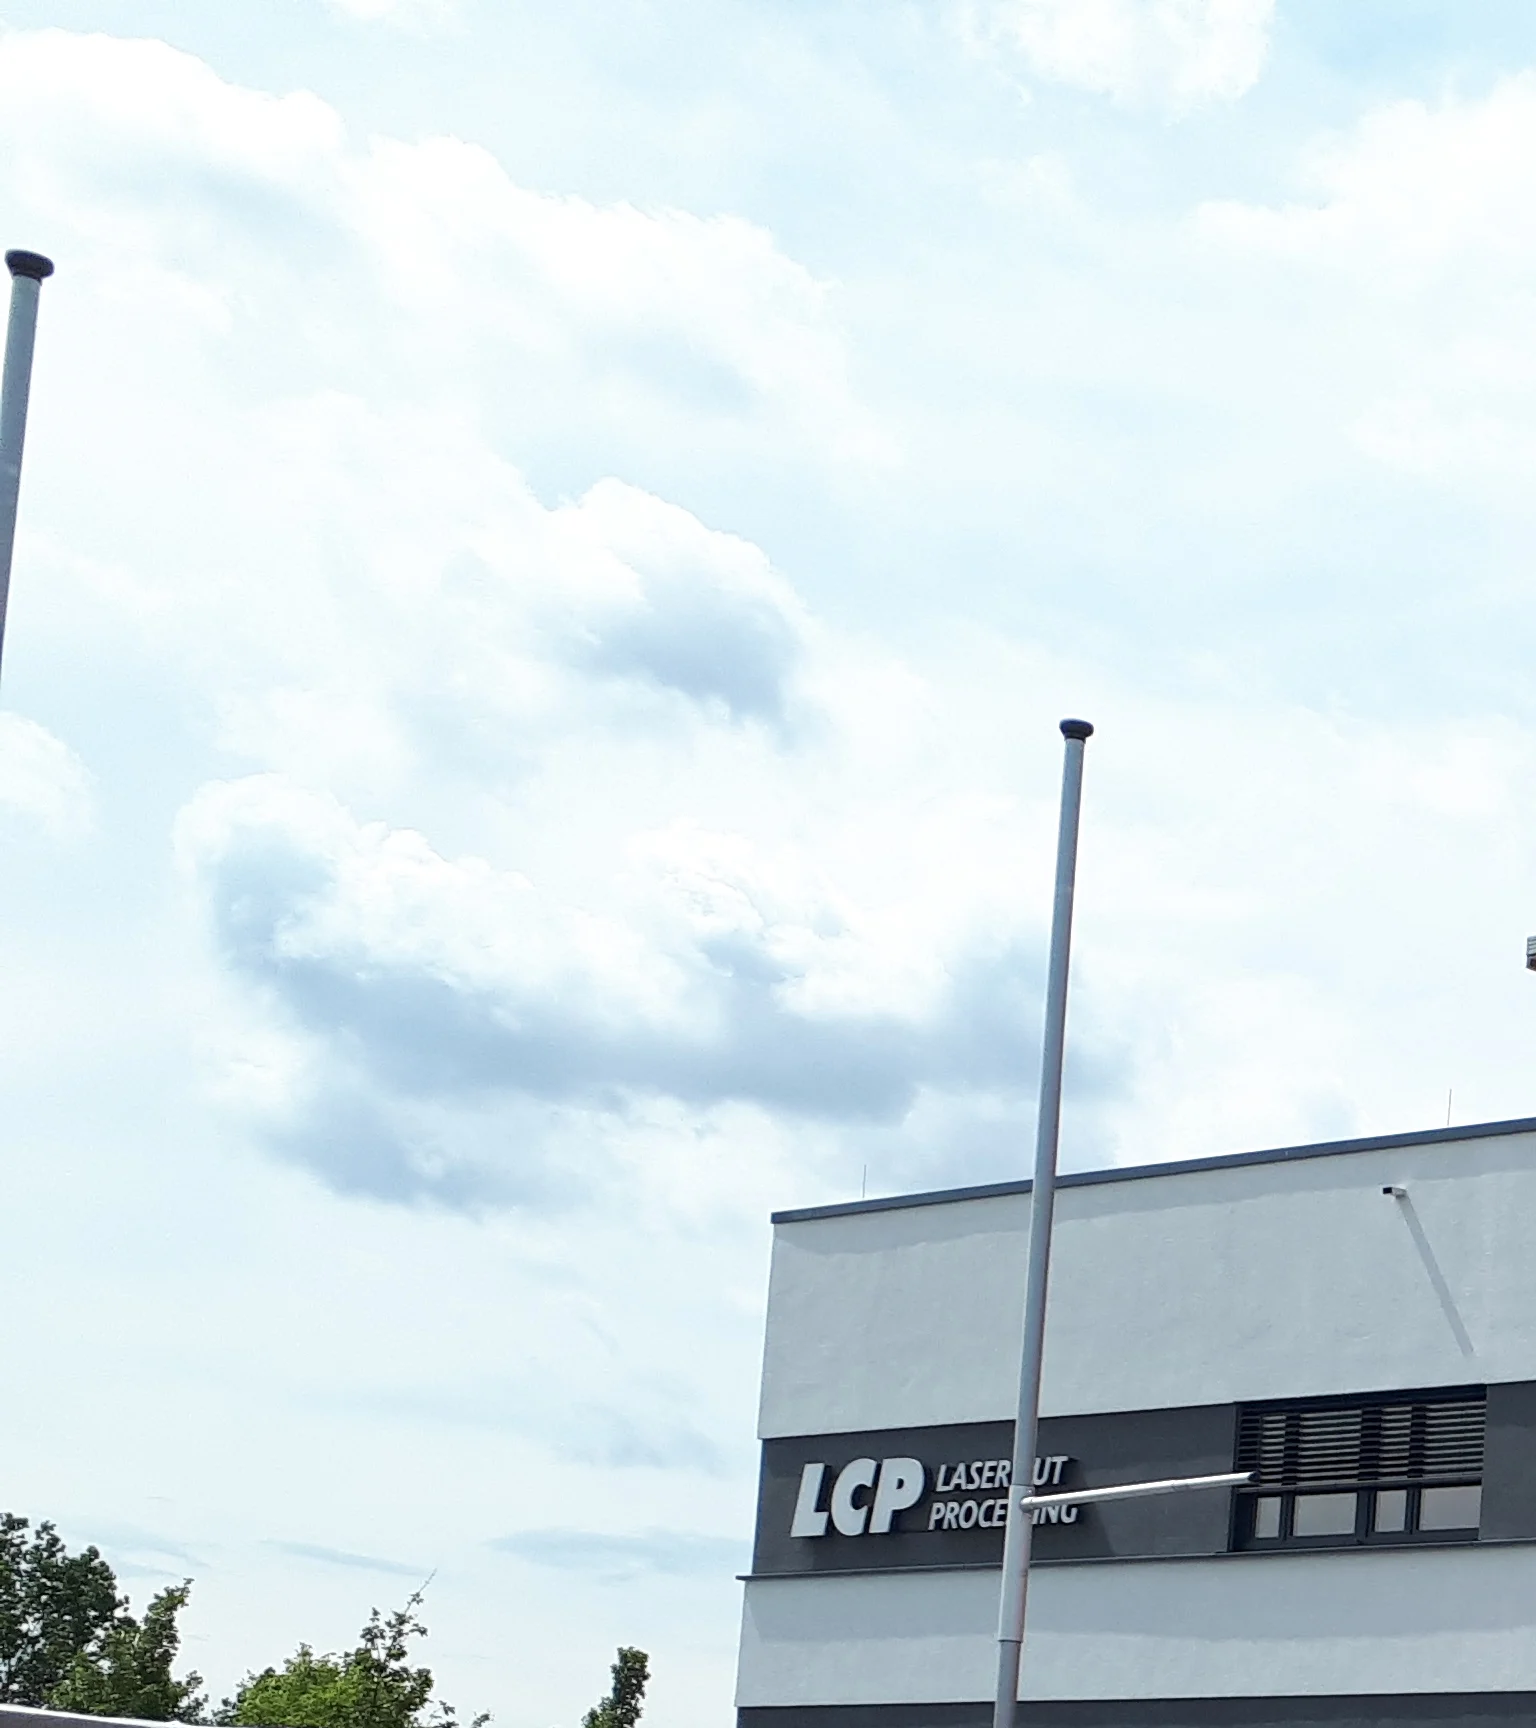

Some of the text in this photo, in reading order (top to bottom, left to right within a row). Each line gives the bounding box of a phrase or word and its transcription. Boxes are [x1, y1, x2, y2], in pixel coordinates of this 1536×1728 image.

[935, 1455, 1069, 1492] LASERUT
[790, 1457, 925, 1538] LCP
[927, 1498, 1078, 1531] PROCEING
